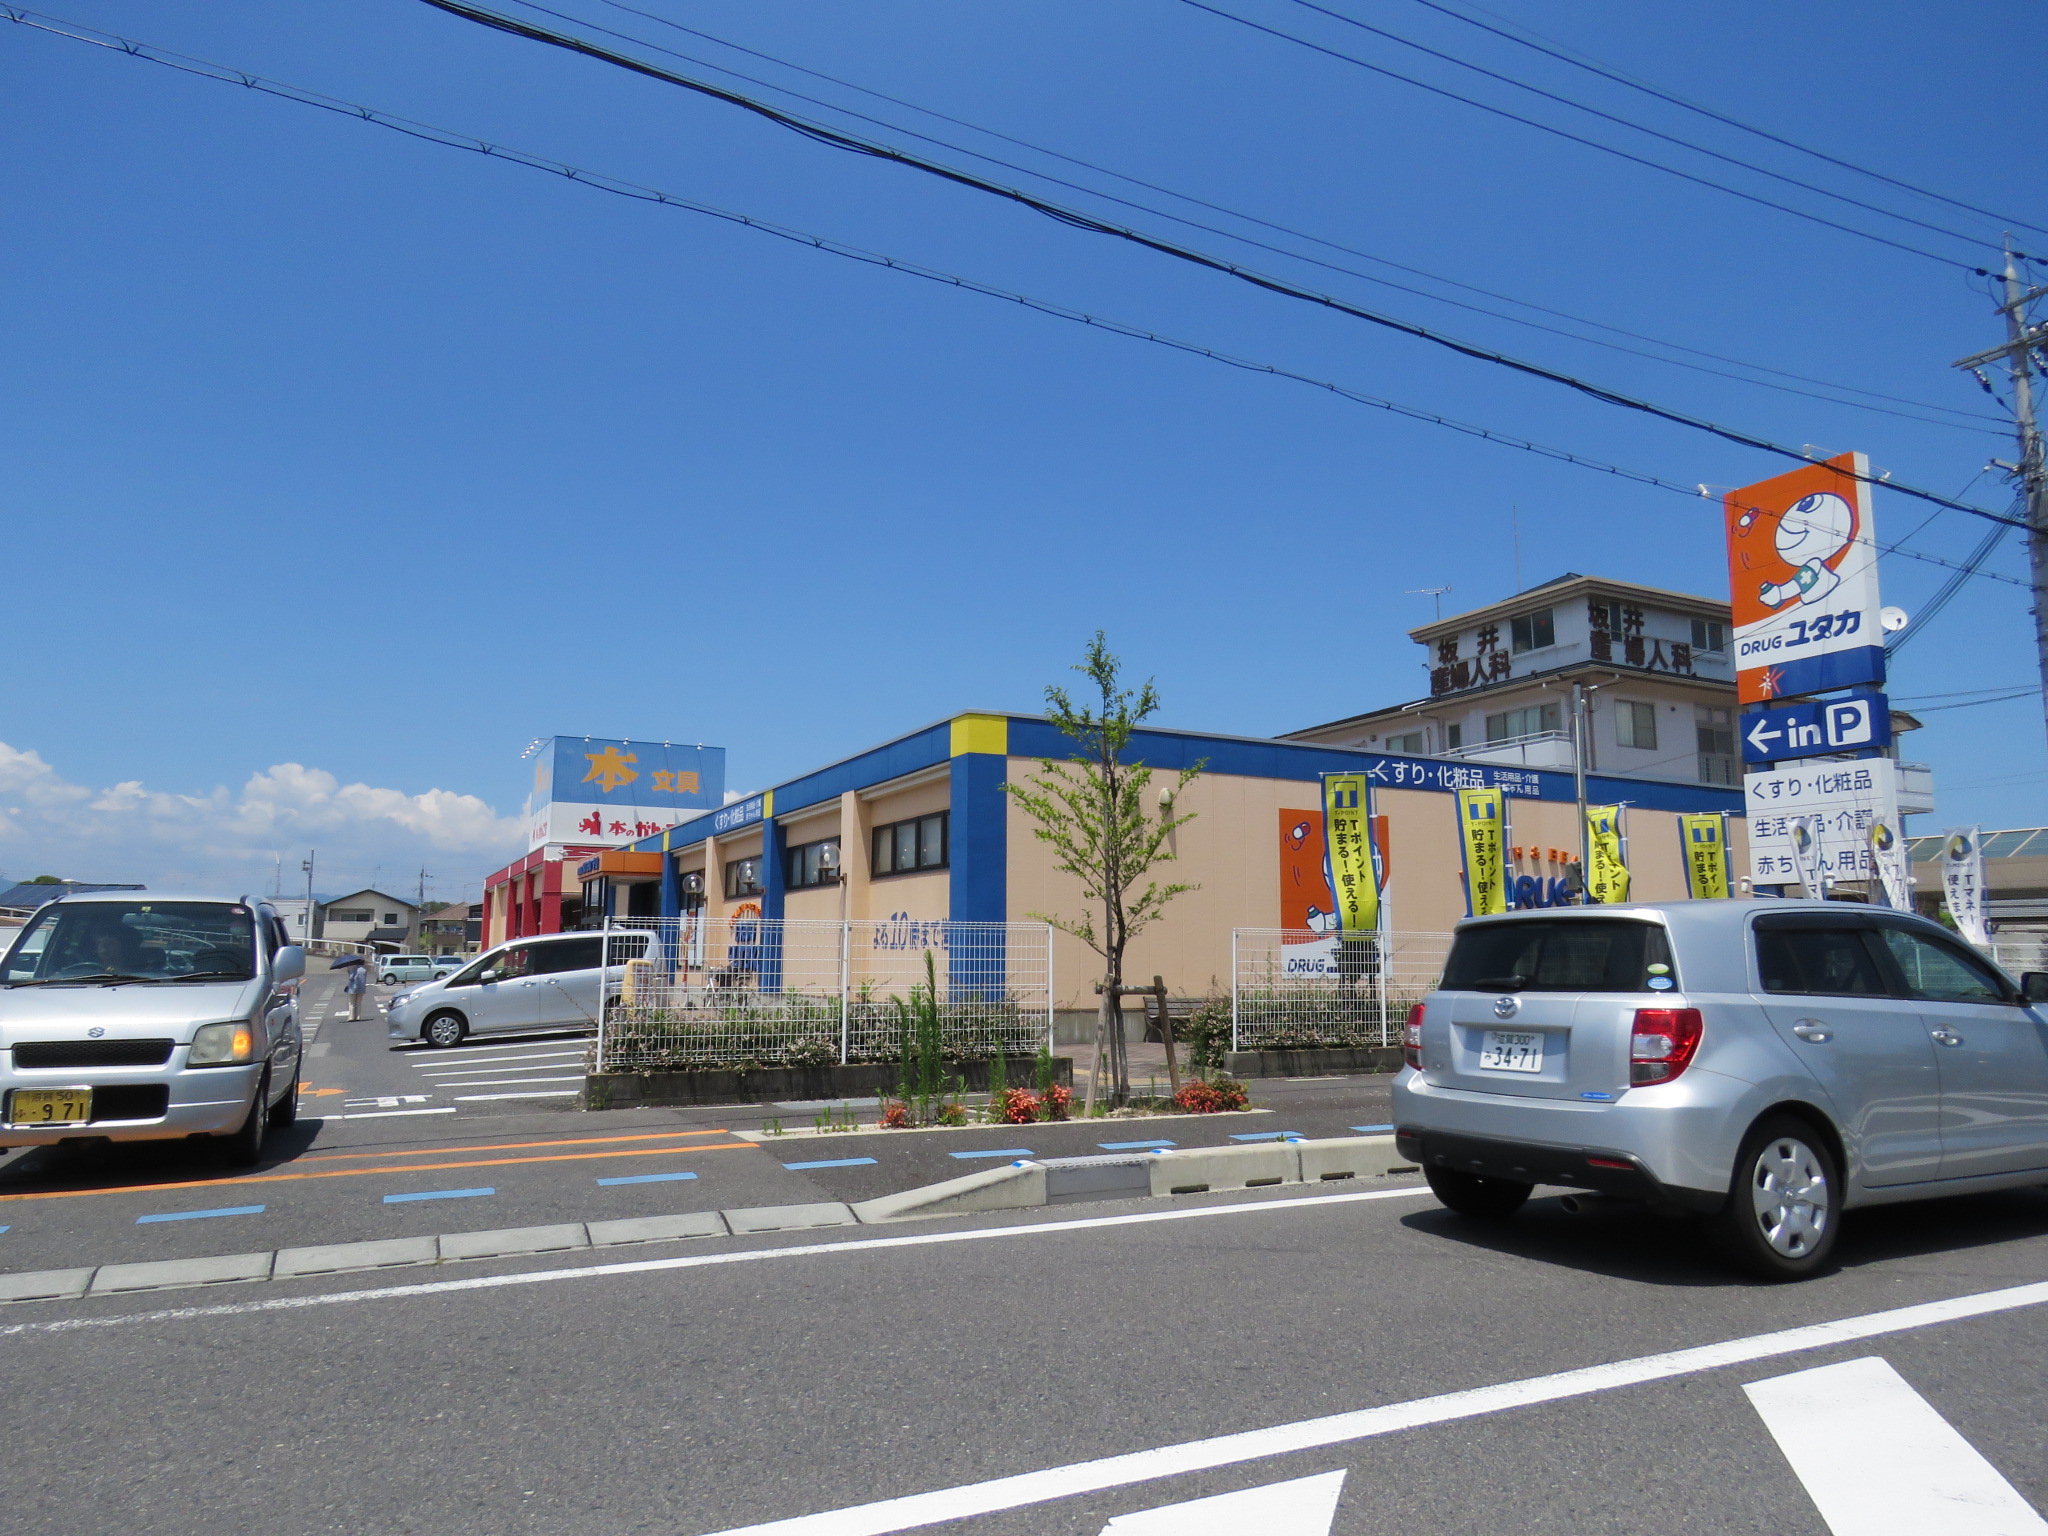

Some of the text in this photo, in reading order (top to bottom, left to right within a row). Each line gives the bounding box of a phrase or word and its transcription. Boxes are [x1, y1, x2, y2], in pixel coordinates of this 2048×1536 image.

[1741, 609, 1862, 656] DRUG ユタカ
[1788, 706, 1862, 748] in P
[581, 746, 640, 793] 本
[651, 769, 699, 794] 文具
[1374, 760, 1485, 790] くすり・化粧品
[1752, 769, 1873, 800] くすり・化粧品
[1350, 819, 1366, 883] Tポイント
[1487, 829, 1497, 890] Tポイント
[1757, 850, 1872, 875] 赤ちん用品
[1963, 874, 1976, 925] Tマネー
[1287, 958, 1325, 973] DRUG
